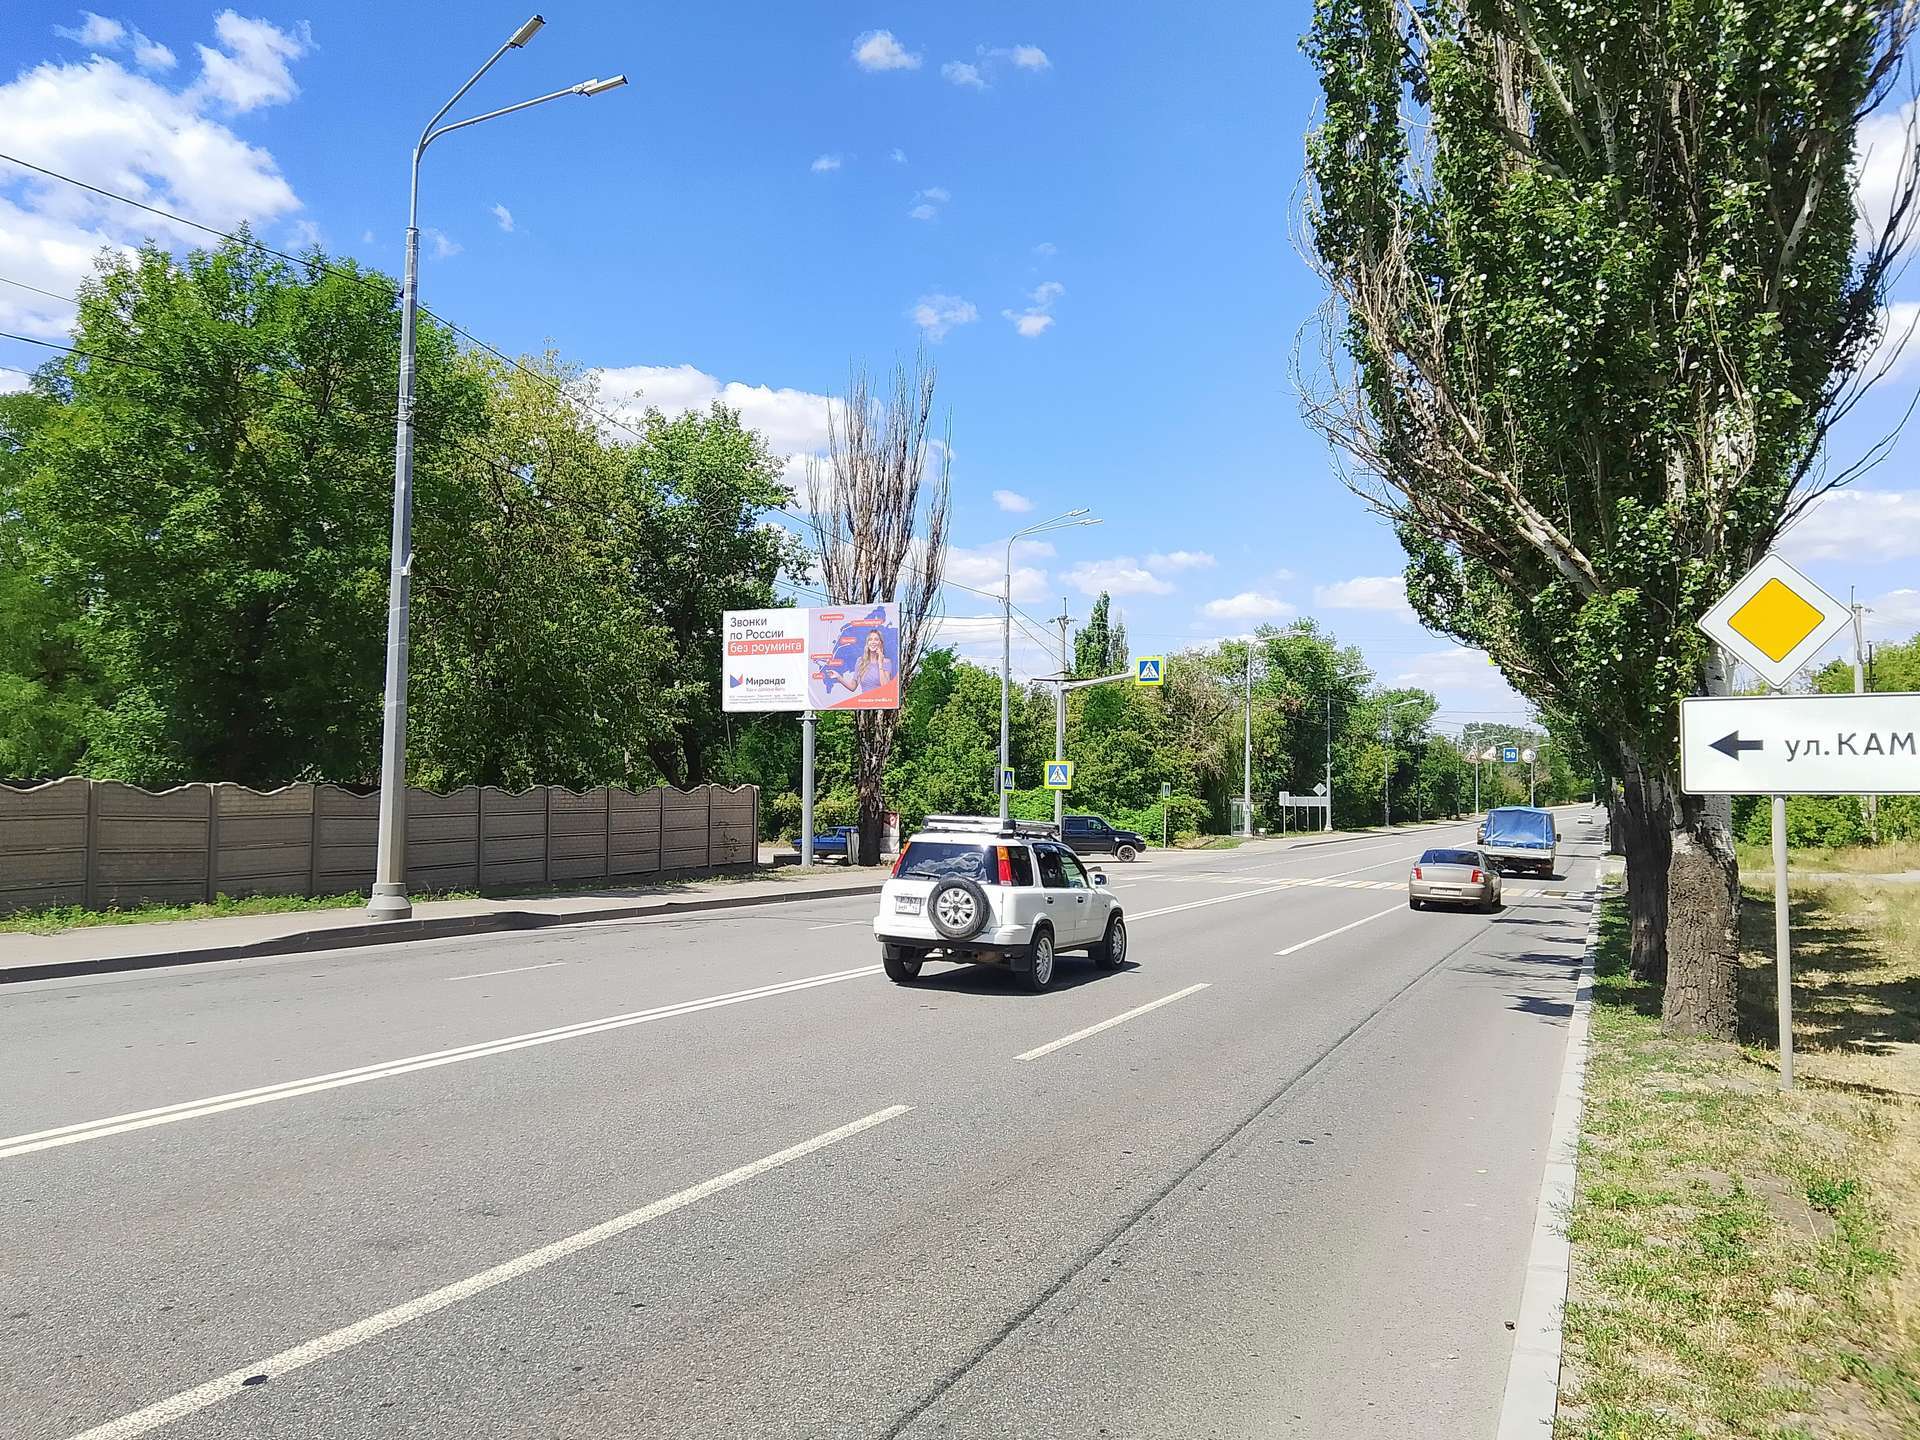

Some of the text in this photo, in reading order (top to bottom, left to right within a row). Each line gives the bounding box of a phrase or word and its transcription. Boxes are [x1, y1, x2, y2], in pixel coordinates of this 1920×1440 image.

[730, 617, 767, 627] Звонки
[730, 629, 784, 640] по России
[730, 642, 801, 654] без роуминга
[745, 677, 786, 687] Миранда
[1505, 751, 1516, 759] 50
